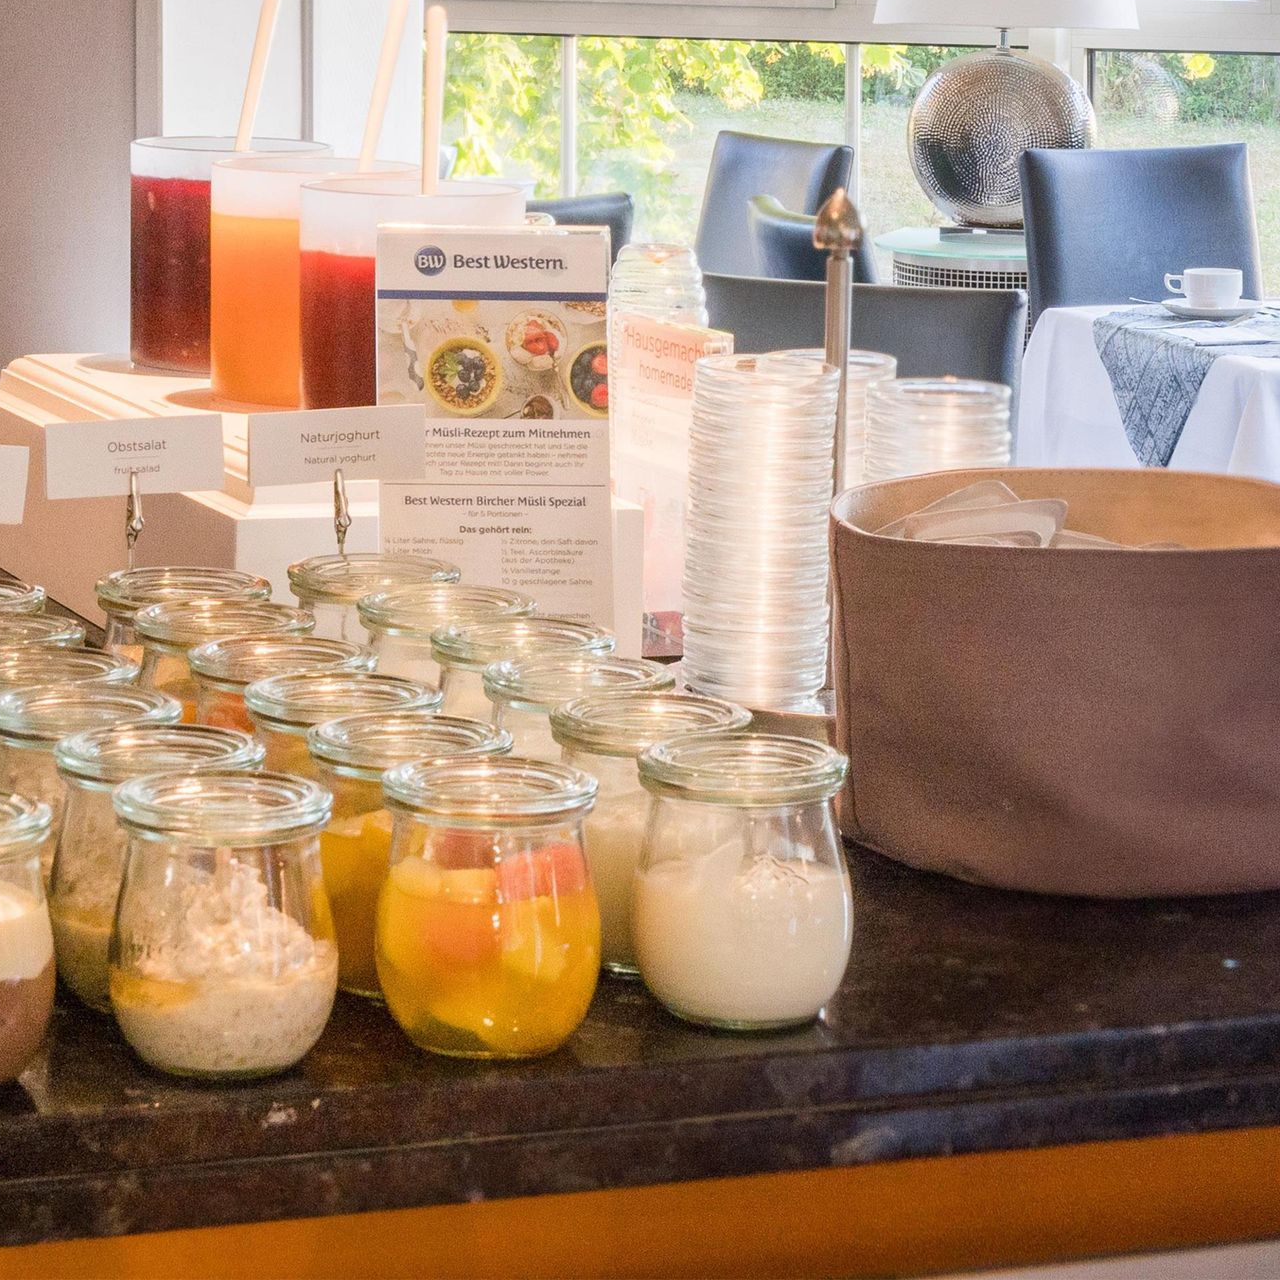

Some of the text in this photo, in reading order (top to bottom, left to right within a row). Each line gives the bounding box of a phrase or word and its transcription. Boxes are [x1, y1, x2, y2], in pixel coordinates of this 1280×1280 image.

[417, 254, 445, 269] BW
[453, 254, 490, 269] Best
[639, 363, 693, 392] homemade
[300, 429, 381, 444] Naturjoghurt
[432, 428, 500, 440] Müsli-Rezept
[502, 430, 526, 438] zum
[528, 428, 591, 439] Mitnehmen
[107, 439, 168, 453] Obstsalat
[304, 453, 377, 465] Natural yoghurt
[114, 464, 161, 475] fruit salad
[404, 496, 587, 509] Best Western Bircher Müsli Spezial
[459, 525, 532, 535] Das gehört rein:
